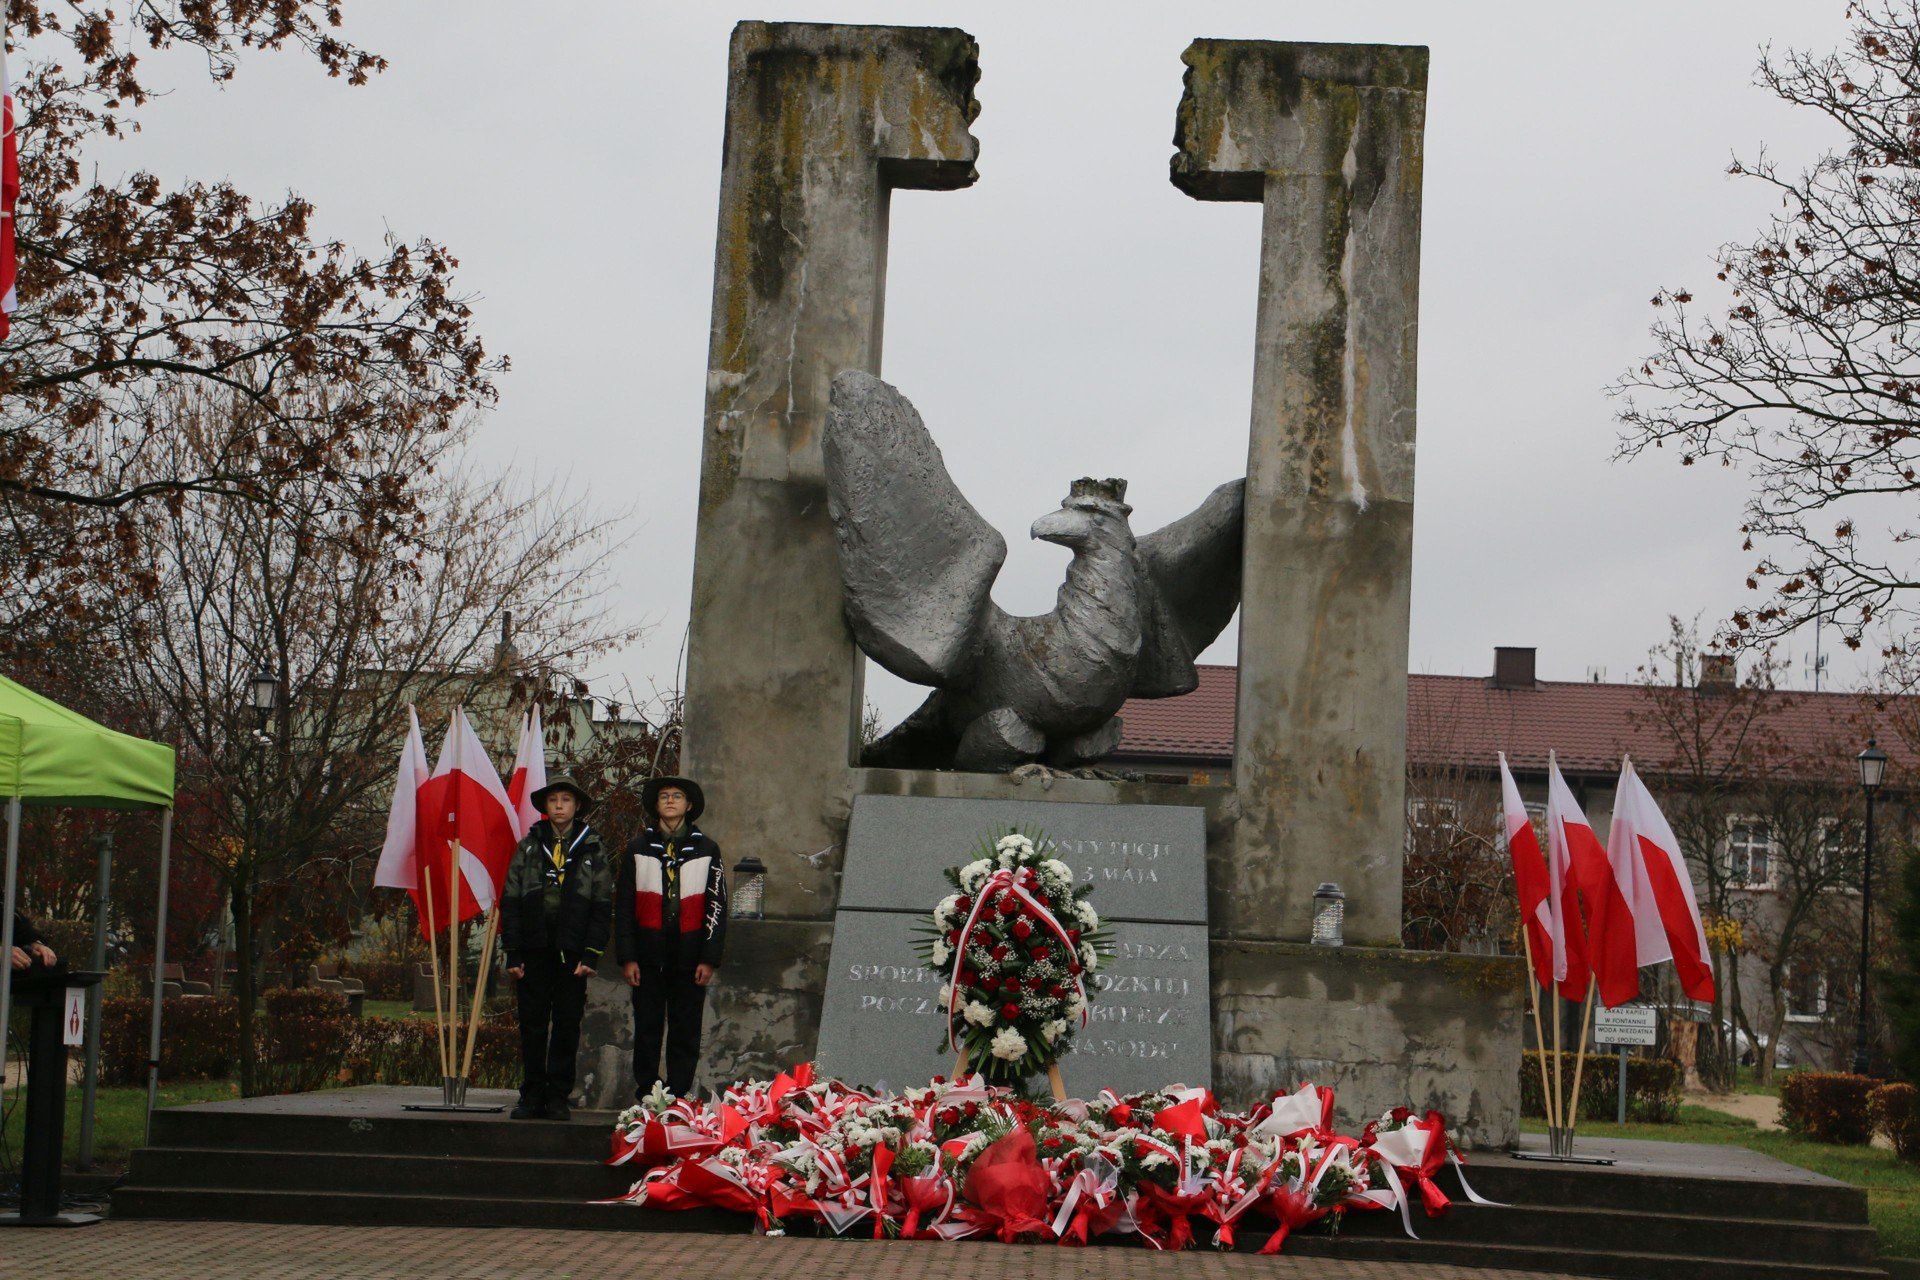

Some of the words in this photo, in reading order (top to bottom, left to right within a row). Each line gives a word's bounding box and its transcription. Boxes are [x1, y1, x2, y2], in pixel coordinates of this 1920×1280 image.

[1081, 866, 1094, 882] 3
[1102, 868, 1158, 884] MAJA
[861, 995, 938, 1014] POCZ
